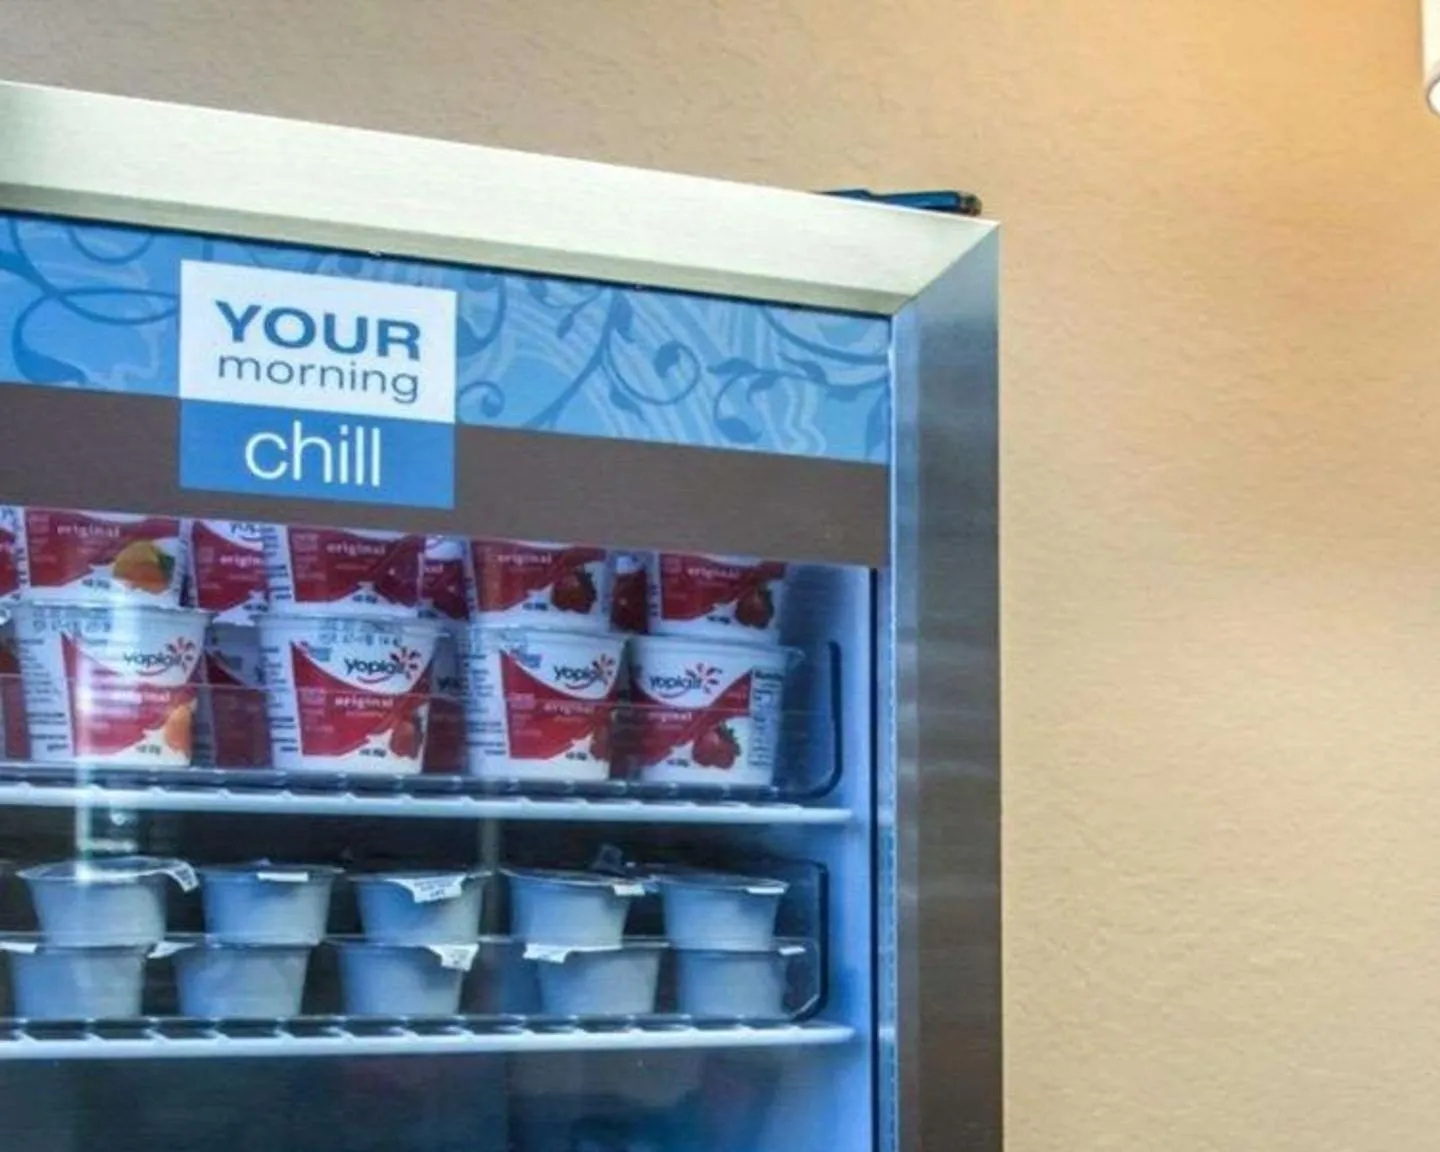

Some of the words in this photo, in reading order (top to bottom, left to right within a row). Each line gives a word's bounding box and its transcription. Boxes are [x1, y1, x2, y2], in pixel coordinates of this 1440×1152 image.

[215, 300, 420, 361] YOUR
[218, 355, 419, 404] morning
[245, 420, 380, 487] chill
